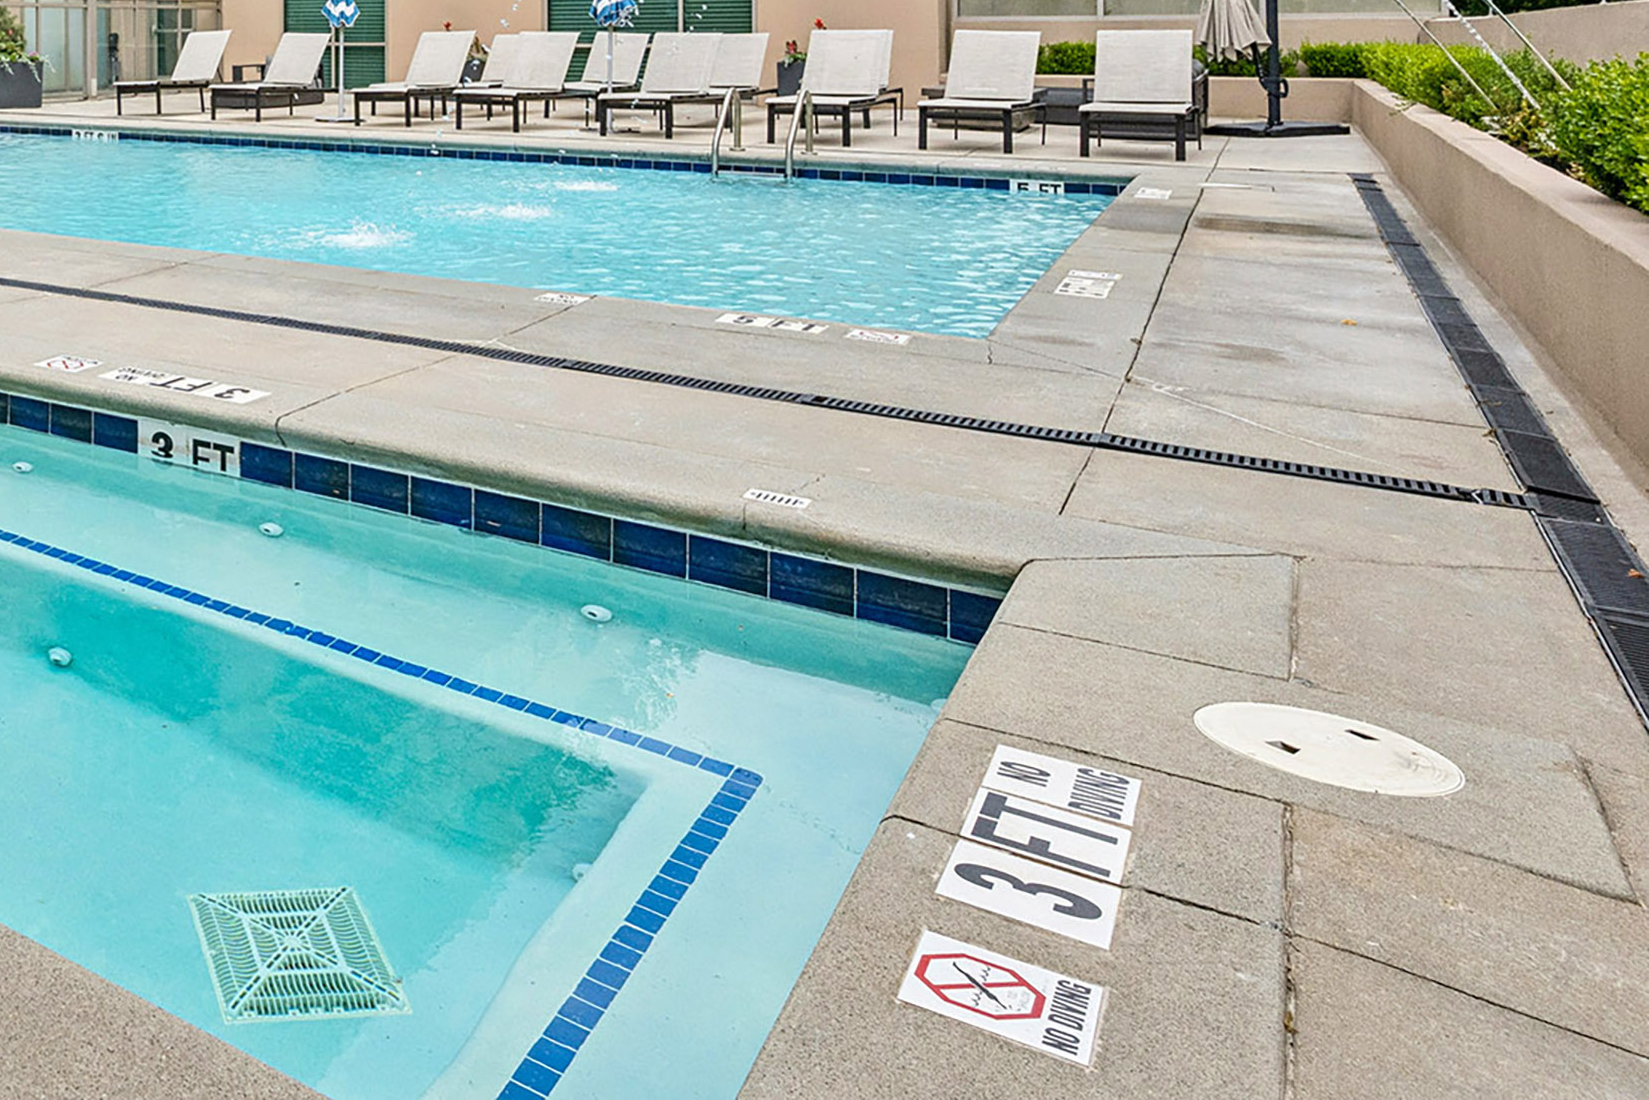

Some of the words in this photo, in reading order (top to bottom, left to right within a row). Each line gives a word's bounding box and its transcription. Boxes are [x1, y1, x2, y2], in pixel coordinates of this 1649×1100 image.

[149, 376, 213, 392] FT
[214, 387, 251, 399] 3
[151, 431, 174, 459] 3
[192, 438, 235, 472] FT
[997, 760, 1051, 788] NO
[1067, 767, 1130, 821] DIVING
[970, 791, 1119, 878] FT
[954, 862, 1103, 920] 3
[1048, 979, 1092, 1032] DIVING
[1042, 1027, 1080, 1056] NO
